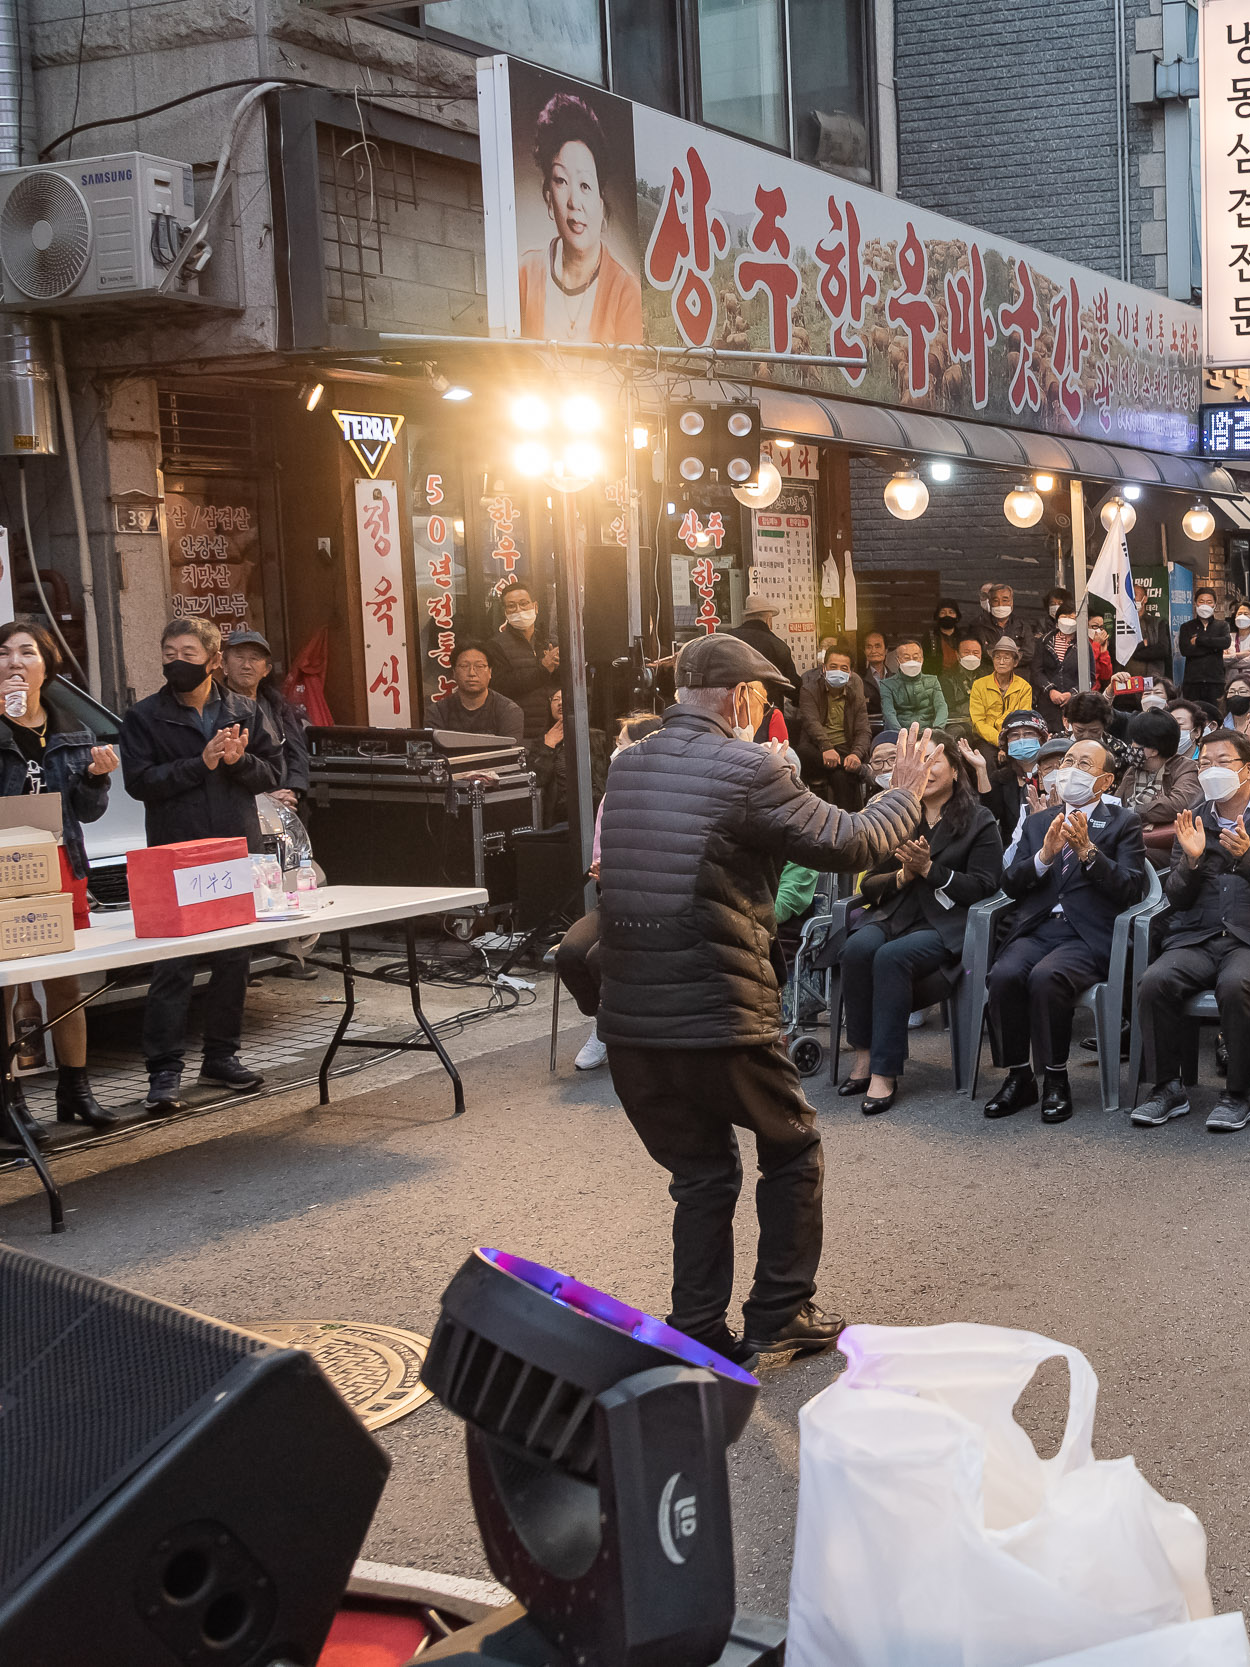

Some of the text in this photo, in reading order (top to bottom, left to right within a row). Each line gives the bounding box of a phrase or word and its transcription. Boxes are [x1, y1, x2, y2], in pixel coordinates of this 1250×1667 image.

[81, 169, 133, 186] SAMSUNG
[339, 414, 397, 444] TERRA
[127, 510, 146, 527] 38
[202, 505, 250, 531] 삼겹살
[678, 508, 726, 550] 상주
[180, 534, 229, 559] 안창살
[181, 564, 231, 589] 치맛살
[171, 593, 249, 618] 생고기모듬
[362, 495, 402, 716] 정육식
